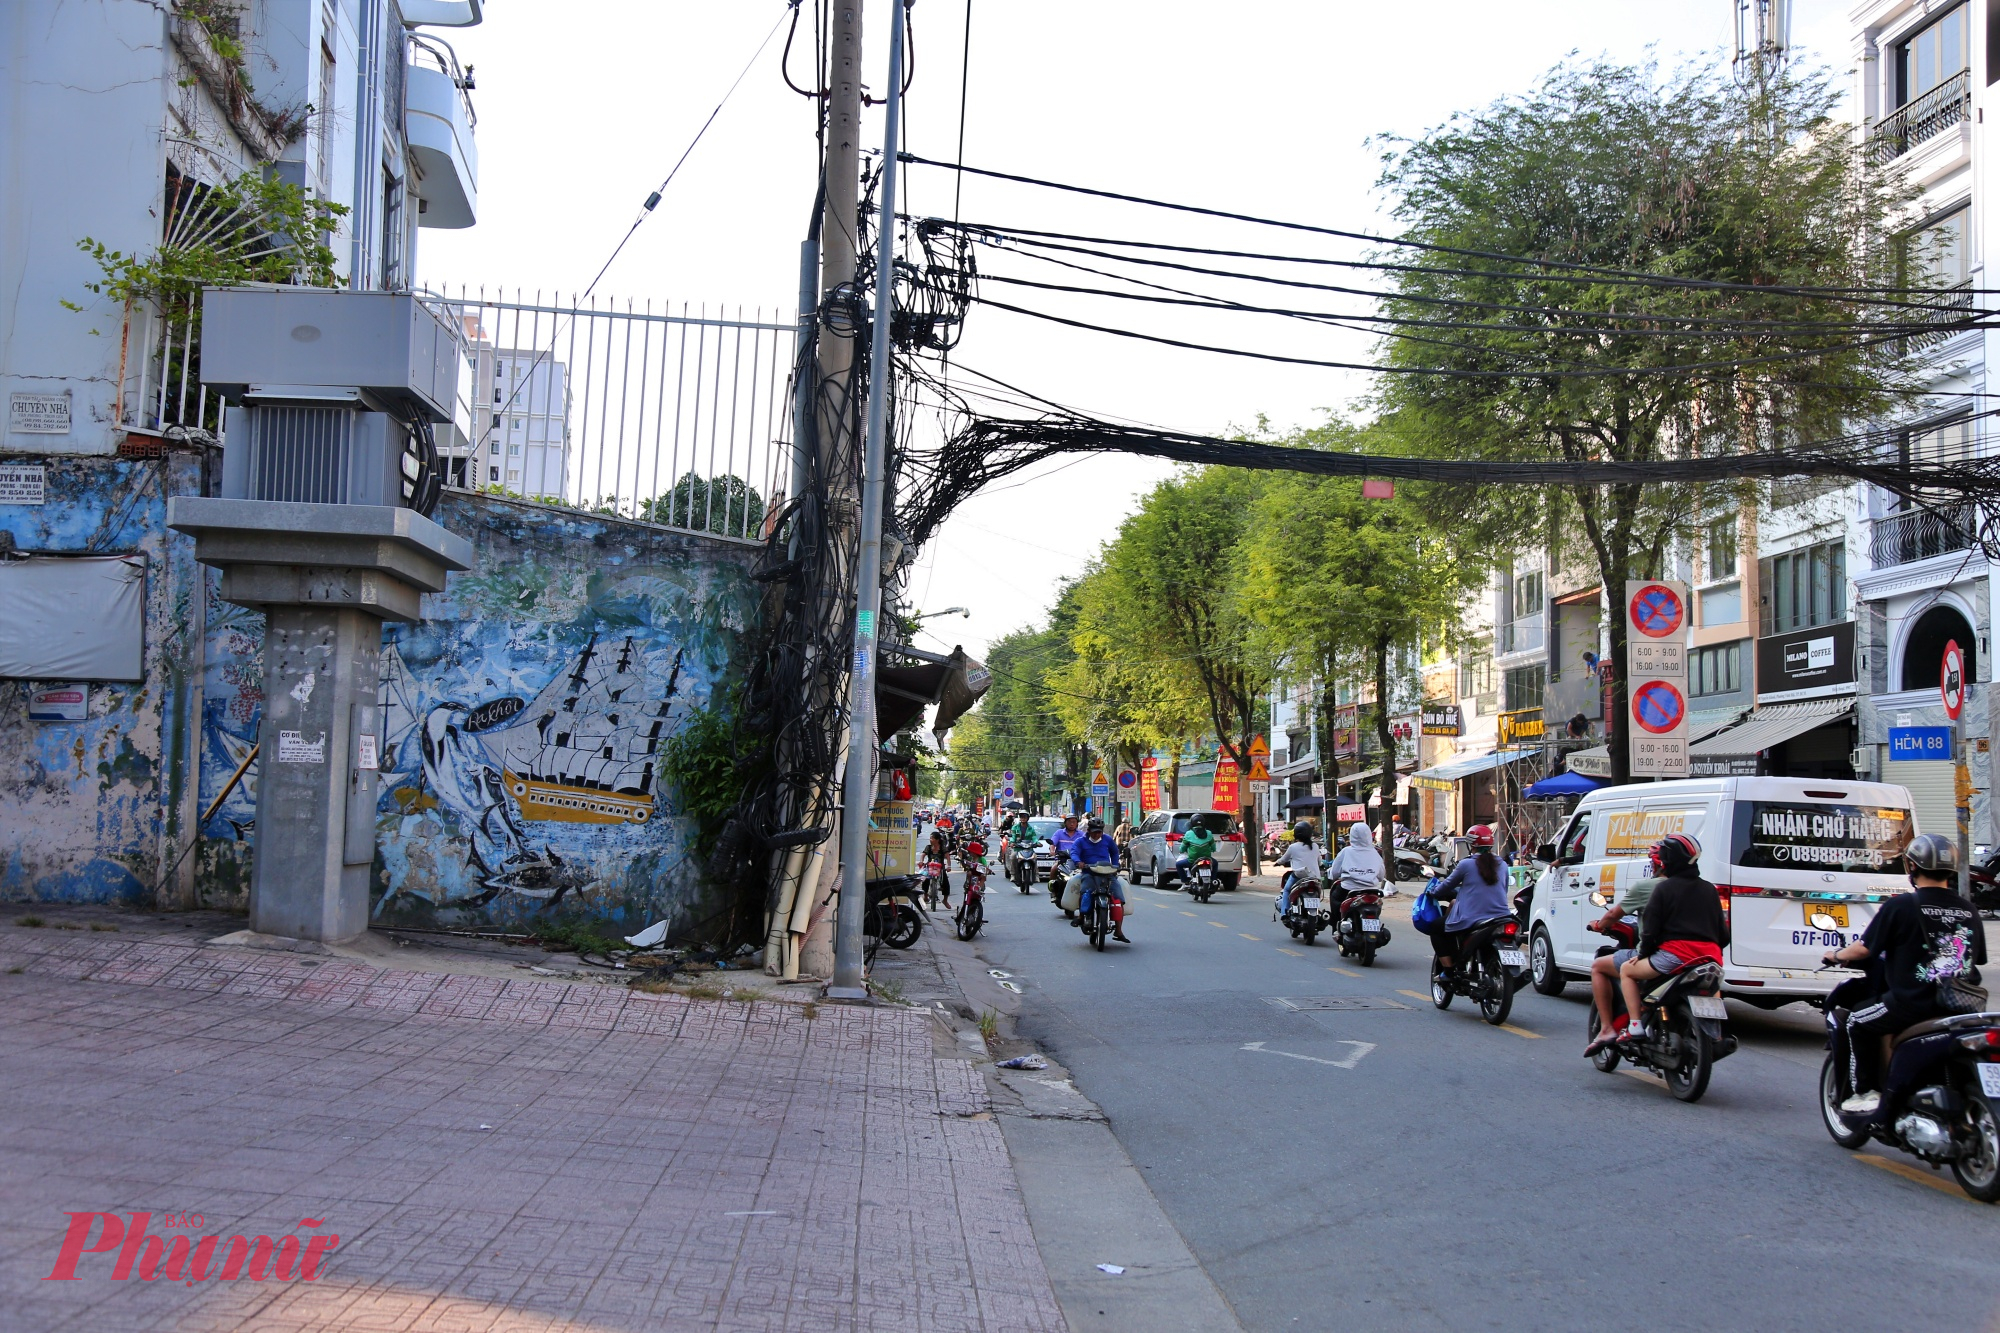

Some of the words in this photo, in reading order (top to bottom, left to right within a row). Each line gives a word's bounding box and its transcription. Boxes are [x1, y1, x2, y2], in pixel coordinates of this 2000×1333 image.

[1638, 648, 1652, 656] 6:00
[1662, 648, 1677, 656] 9:00
[1786, 652, 1808, 662] MILANO
[1810, 648, 1832, 658] COFFEE
[1636, 662, 1653, 670] 16:00
[1662, 662, 1679, 671] 19:00
[1423, 710, 1435, 724] BÚN
[1436, 711, 1444, 725] BÒ
[1446, 710, 1458, 725] HUẾ
[1515, 720, 1544, 737] BARBER
[1640, 744, 1654, 752] 9:00
[1662, 744, 1679, 753] 16:00
[1927, 737, 1943, 749] 88
[1637, 758, 1654, 766] 19:00
[1665, 758, 1683, 767] 22:00
[1694, 757, 1714, 774] NGUYỄN
[894, 815, 909, 828] PHÚC
[1619, 816, 1684, 837] LALAMOVE
[1762, 810, 1808, 841] NHẬN
[1812, 809, 1844, 839] CHỞ
[1849, 814, 1891, 841] HÀNG
[1792, 846, 1883, 866] 0898884226
